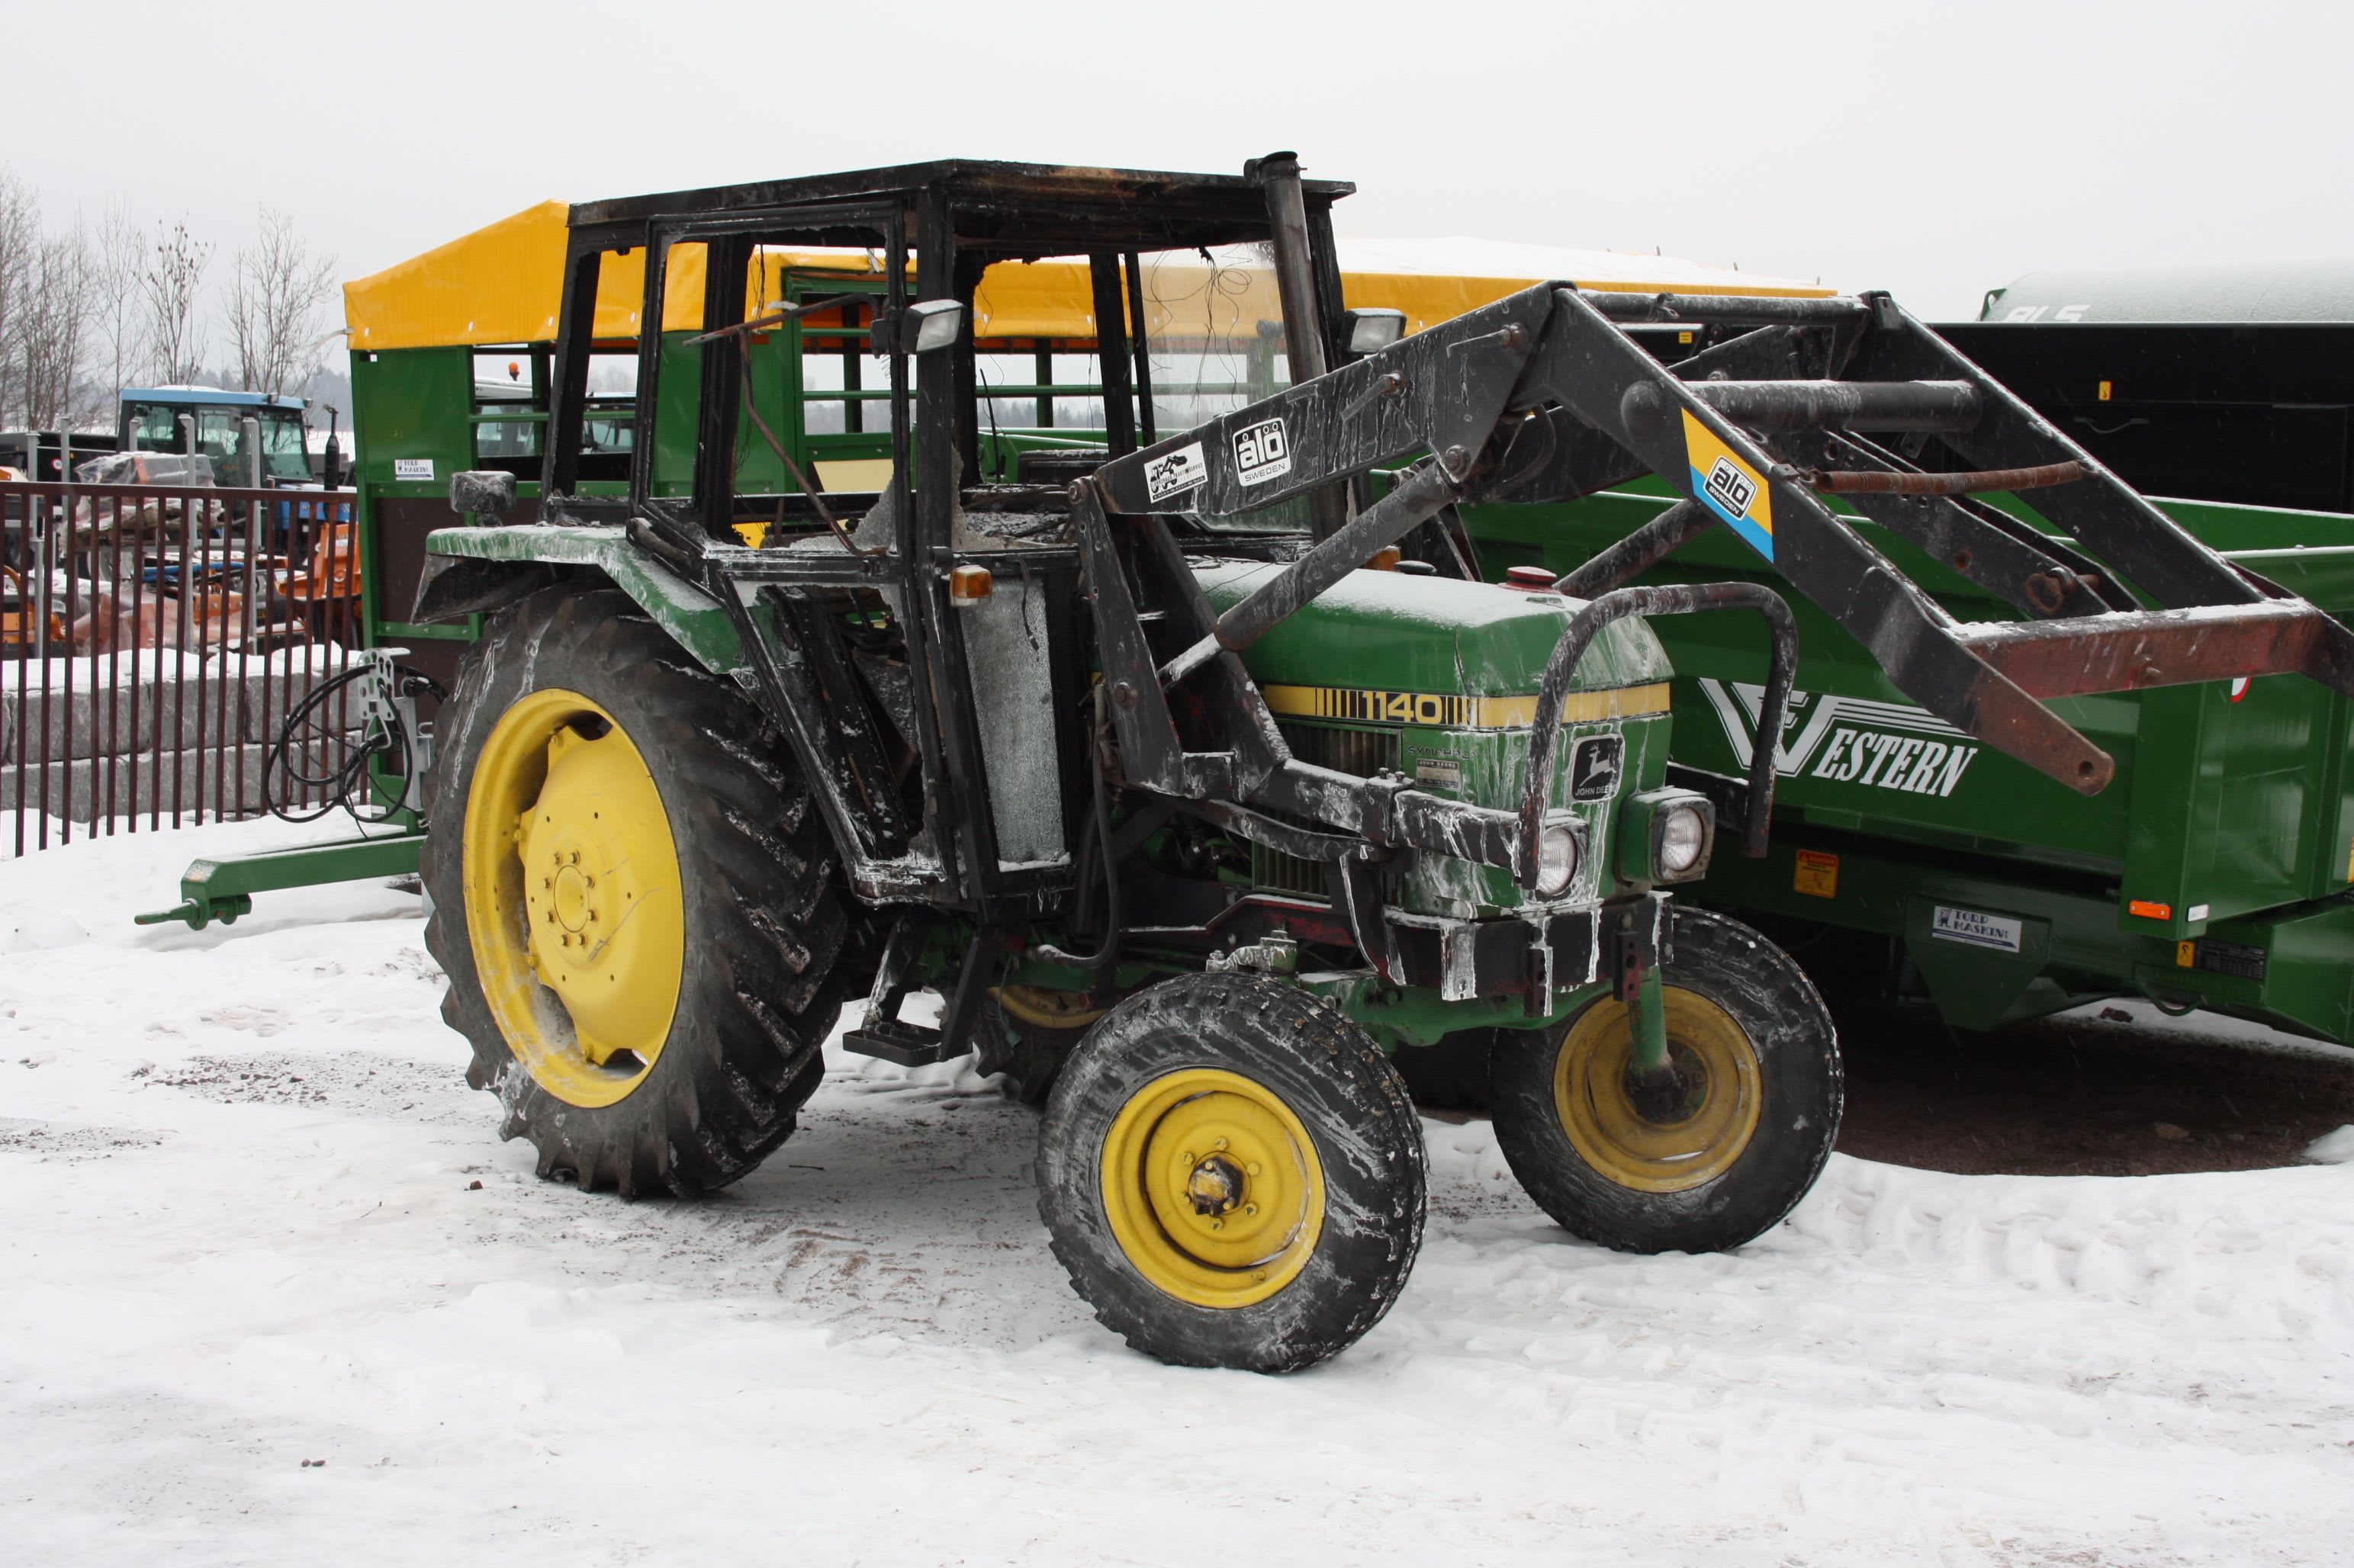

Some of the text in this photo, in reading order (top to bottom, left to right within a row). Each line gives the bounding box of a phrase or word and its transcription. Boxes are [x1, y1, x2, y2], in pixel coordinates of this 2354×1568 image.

[1244, 462, 1285, 482] SWEDEN
[1708, 485, 1740, 515] SWEDEN
[1362, 690, 1443, 725] 1140
[1698, 677, 1979, 798] WESTERN
[1575, 785, 1616, 796] JOHN DEERE
